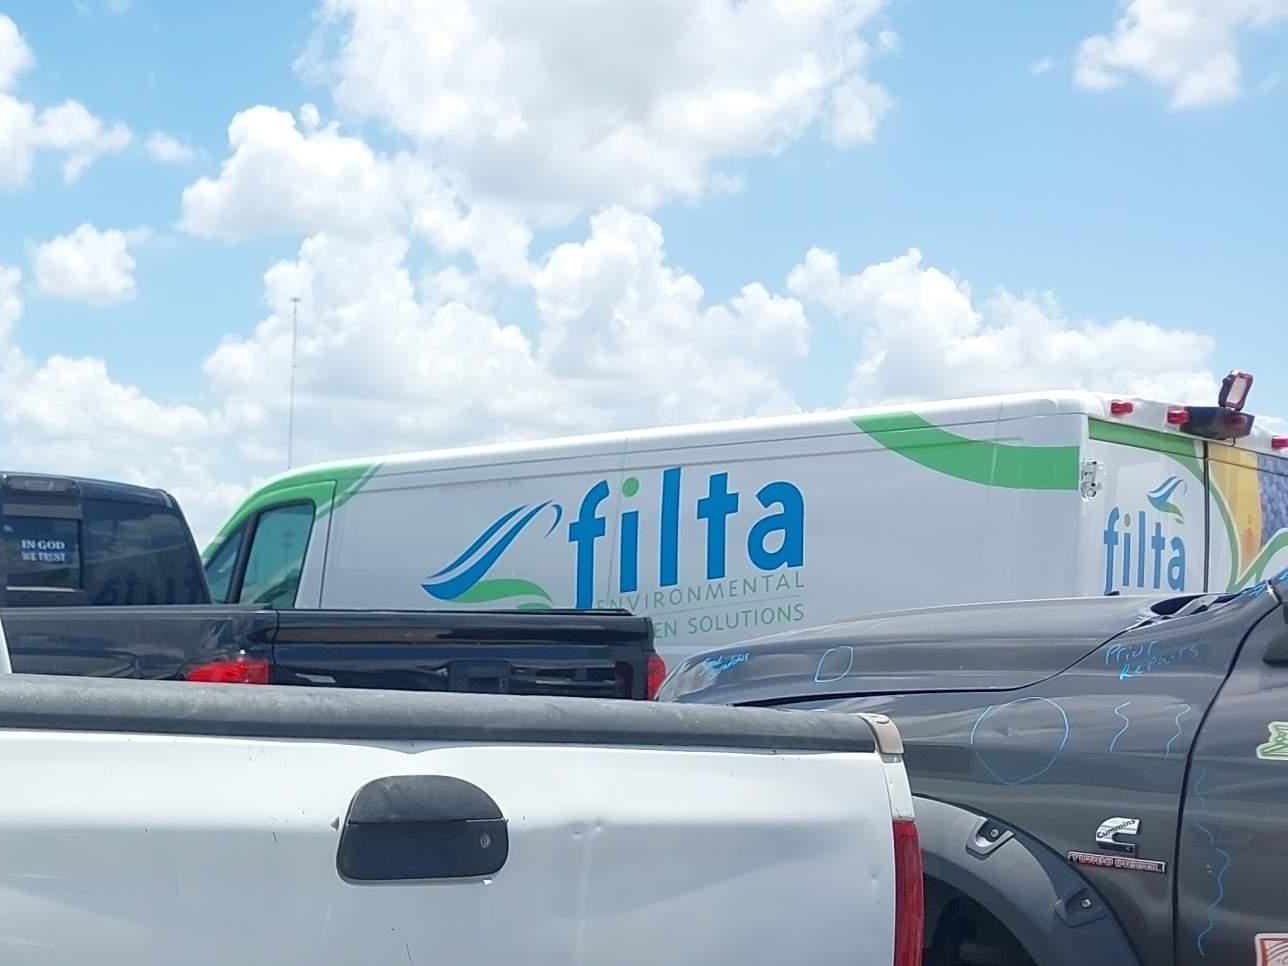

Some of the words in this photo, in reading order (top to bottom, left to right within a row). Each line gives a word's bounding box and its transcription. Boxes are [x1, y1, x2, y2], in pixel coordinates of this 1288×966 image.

[22, 540, 36, 549] IN
[37, 540, 66, 550] GOD
[568, 467, 805, 608] filta
[1104, 506, 1186, 596] filta
[597, 572, 805, 611] ENVIRONMENTAL
[688, 604, 805, 634] SOLUTIONS
[1096, 819, 1136, 839] Cummins
